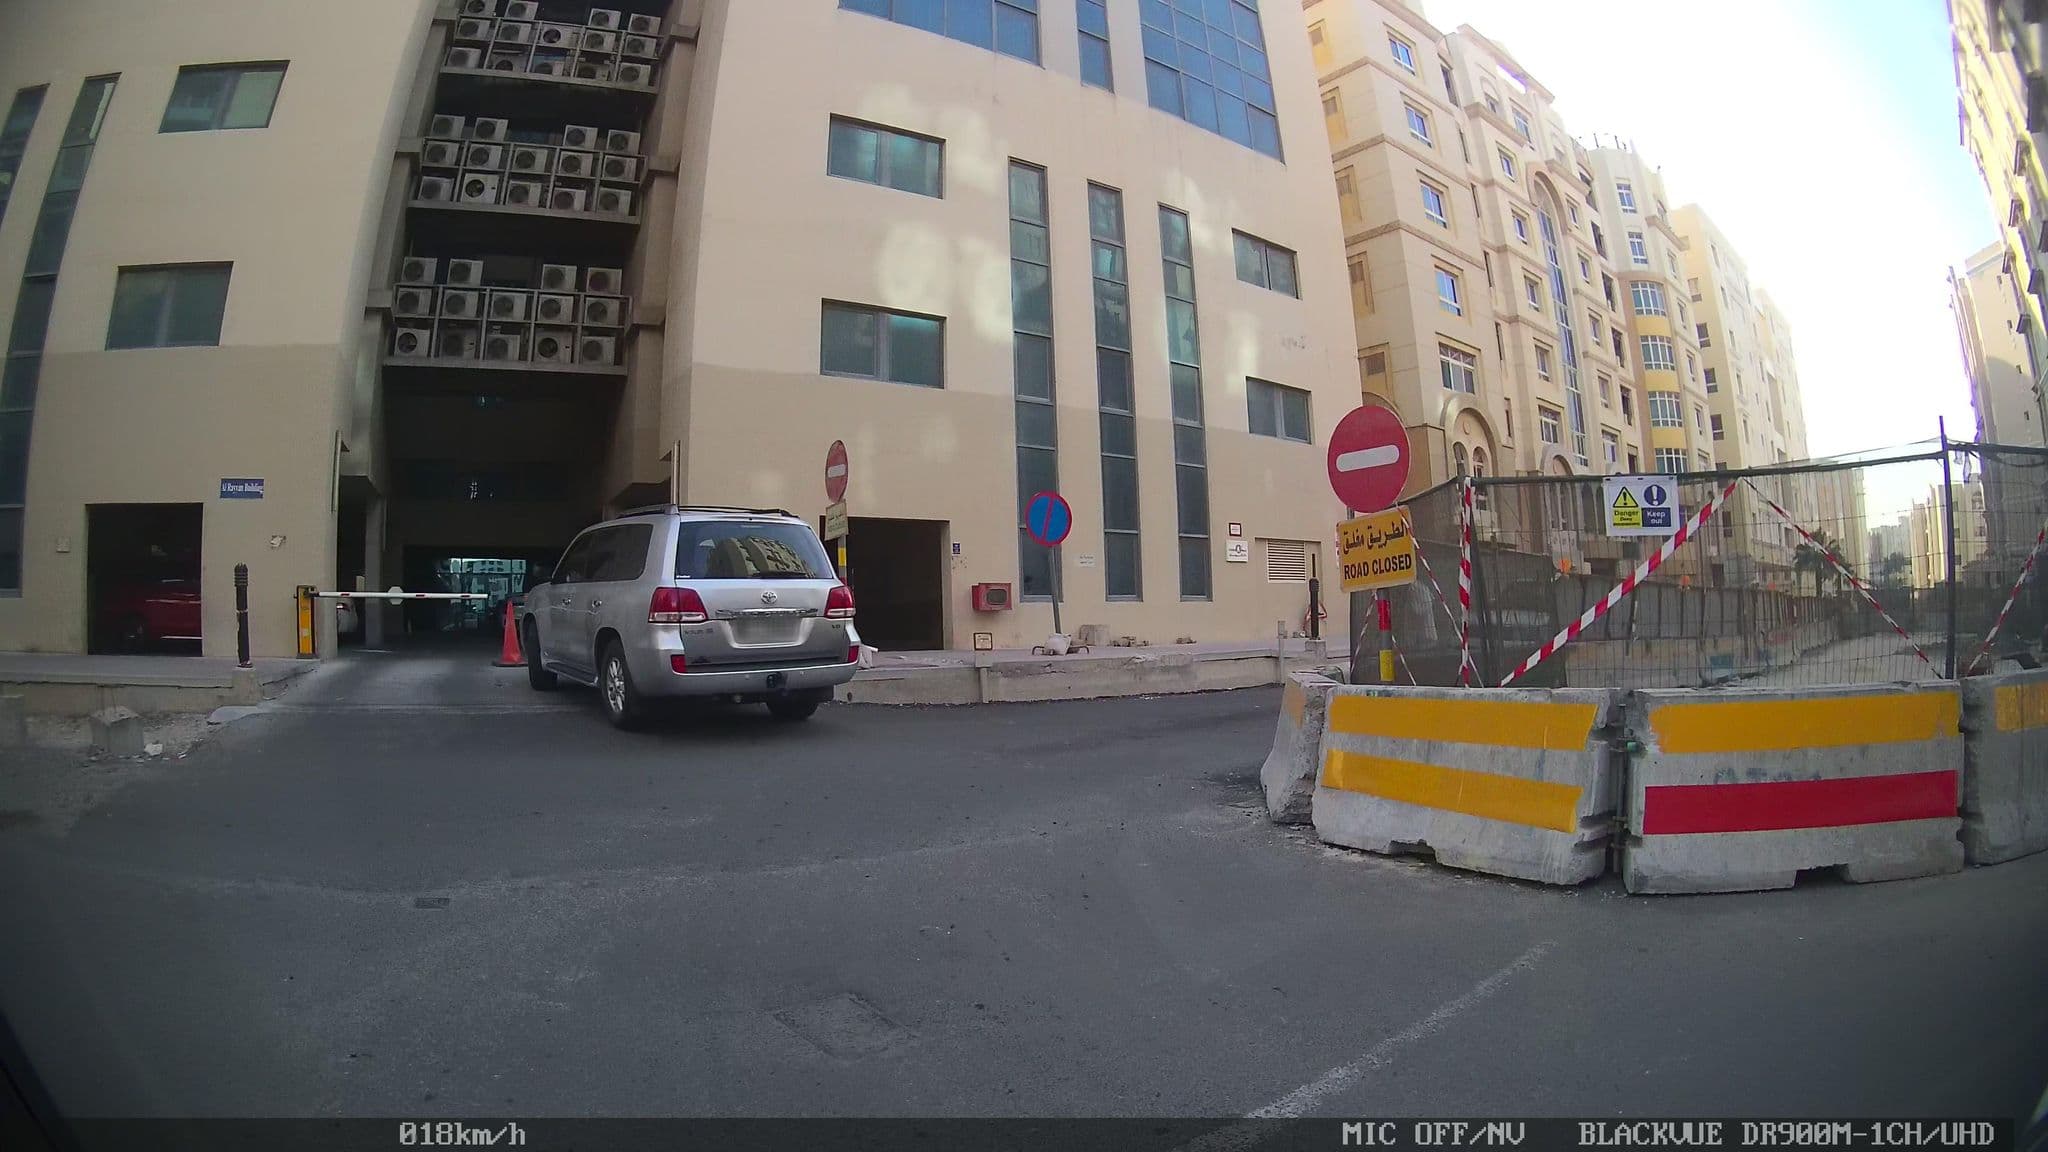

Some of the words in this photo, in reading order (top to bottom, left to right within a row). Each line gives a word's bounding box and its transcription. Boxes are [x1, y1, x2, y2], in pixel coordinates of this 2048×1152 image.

[1647, 510, 1666, 518] Keep
[1343, 528, 1364, 555] مغلق
[1344, 561, 1370, 580] ROAD
[1372, 553, 1412, 575] CLOSED
